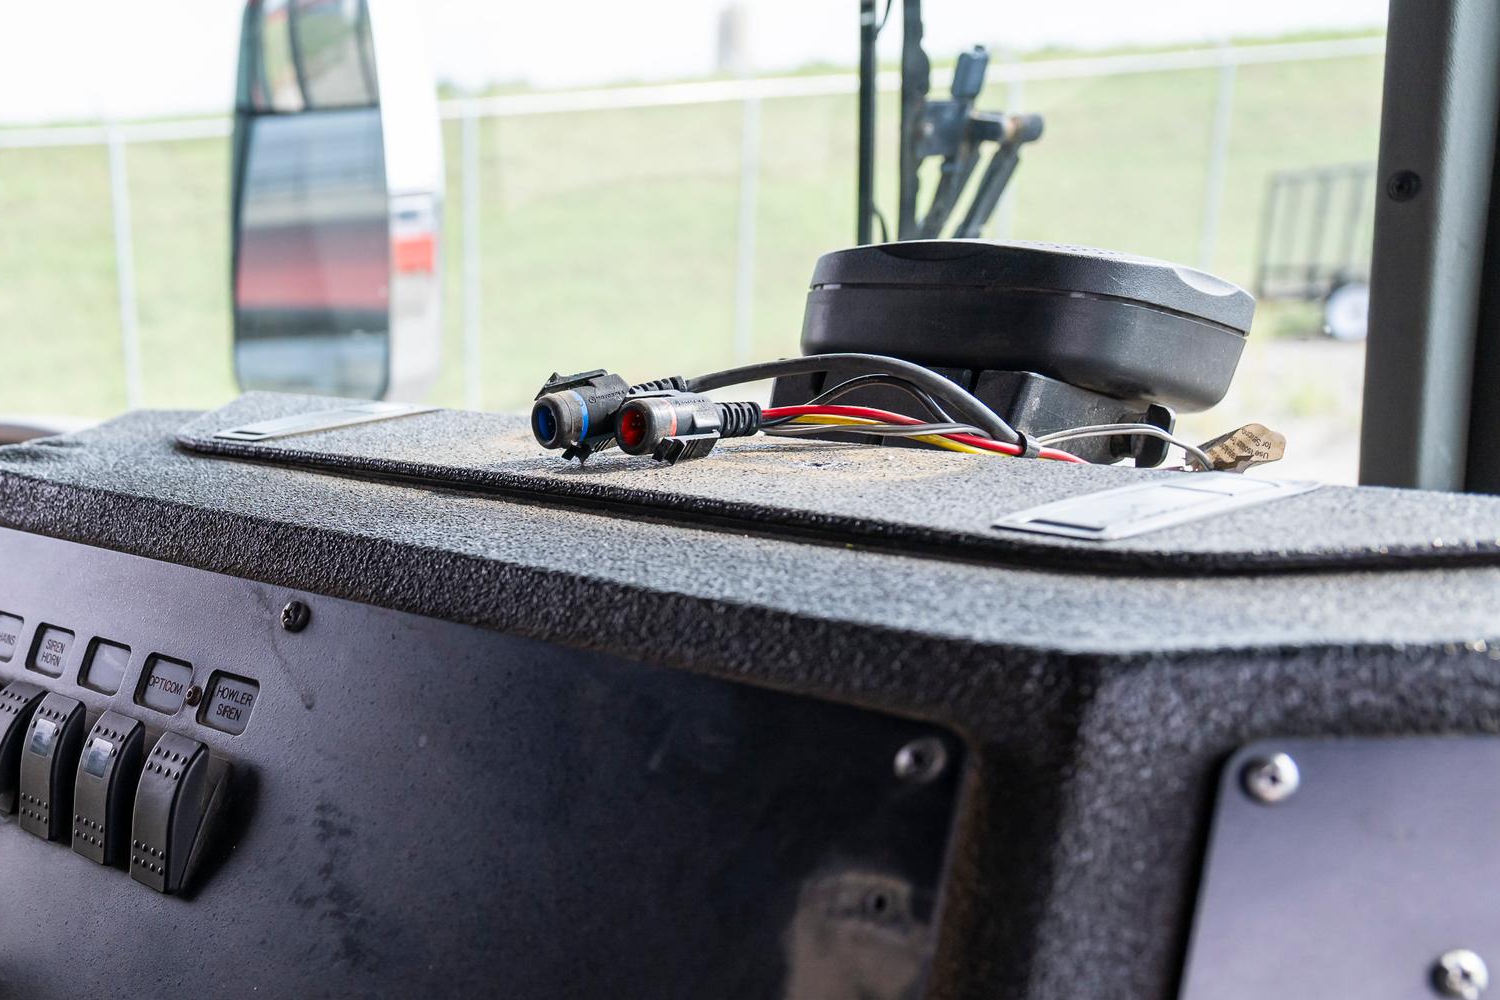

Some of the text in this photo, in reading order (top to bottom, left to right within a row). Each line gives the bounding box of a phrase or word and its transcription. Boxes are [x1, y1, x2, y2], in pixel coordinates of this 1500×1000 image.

[45, 639, 65, 654] SIREN
[41, 652, 61, 667] HORN
[148, 675, 183, 696] OPTICOM
[217, 685, 253, 706] HOWLER
[216, 703, 242, 721] SIREN
